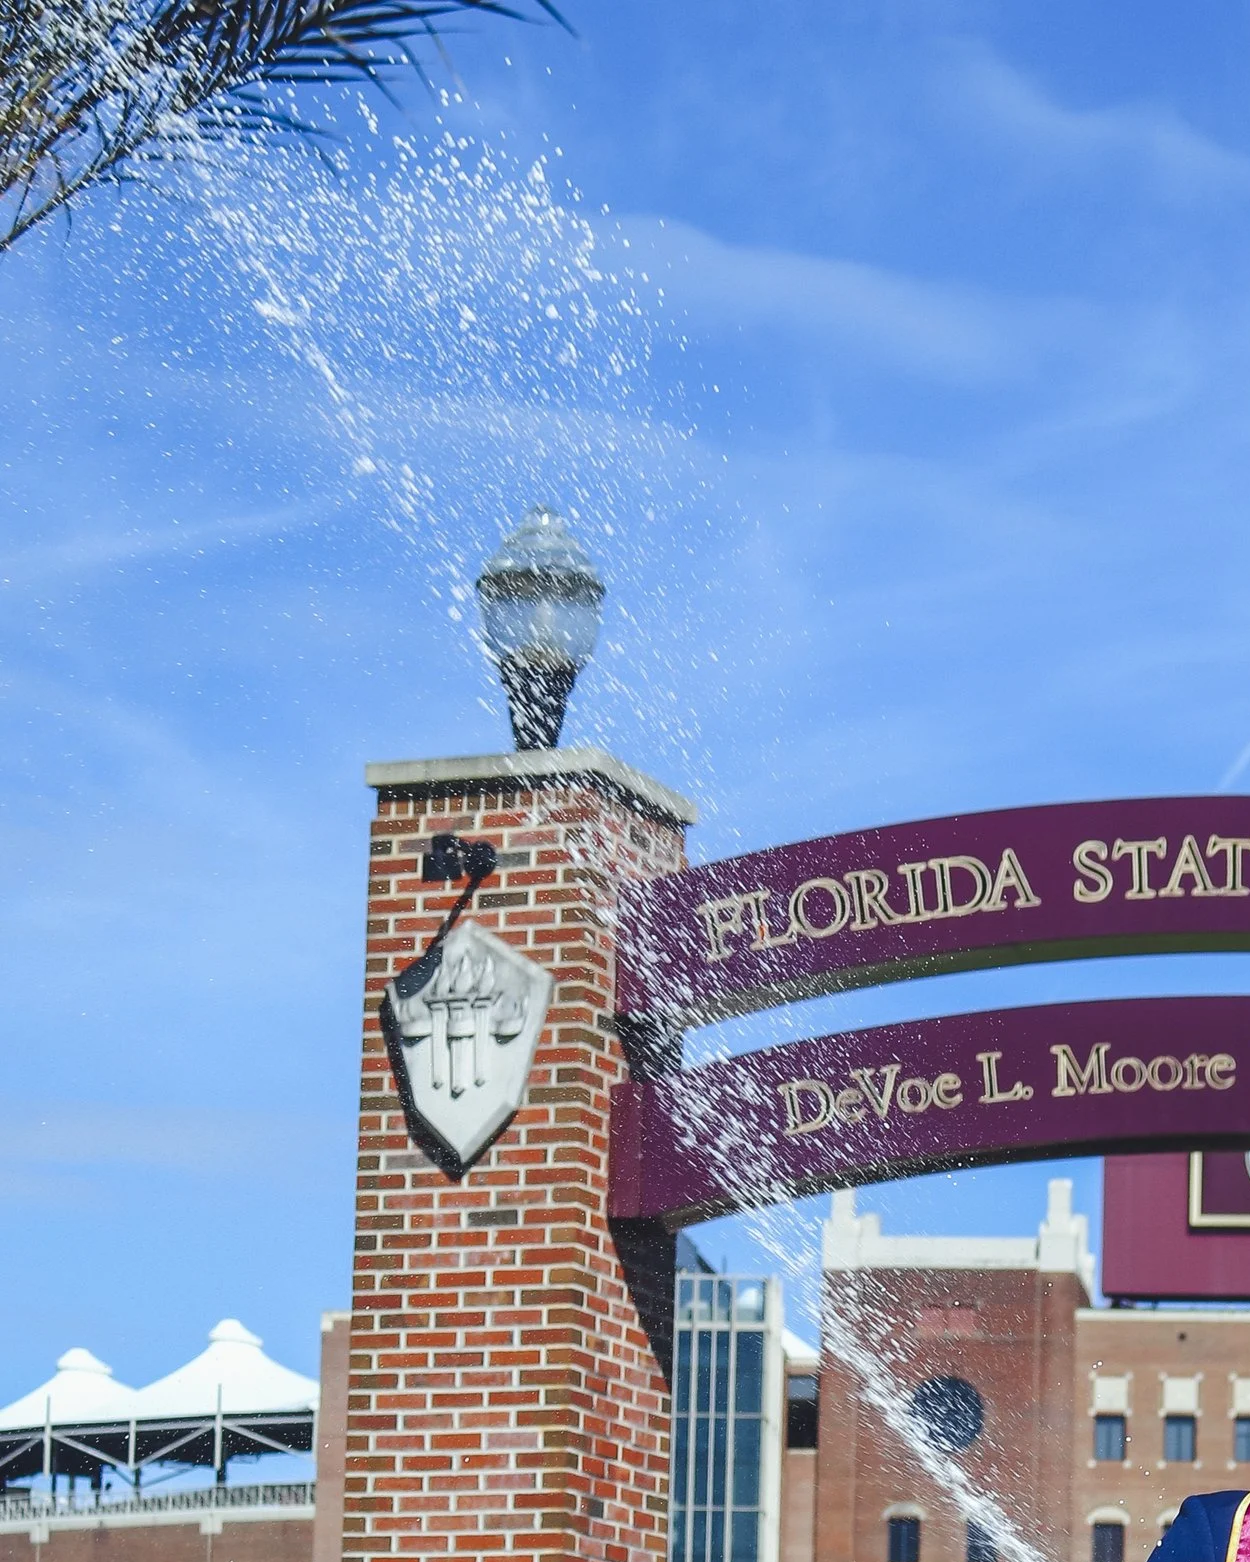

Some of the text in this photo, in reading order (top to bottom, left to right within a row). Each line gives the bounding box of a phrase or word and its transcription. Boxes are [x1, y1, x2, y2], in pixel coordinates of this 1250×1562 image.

[699, 848, 1042, 963] FLORIDA
[778, 1063, 963, 1137] DeVoe
[976, 1051, 1034, 1103] L.
[1050, 1042, 1237, 1098] Moore
